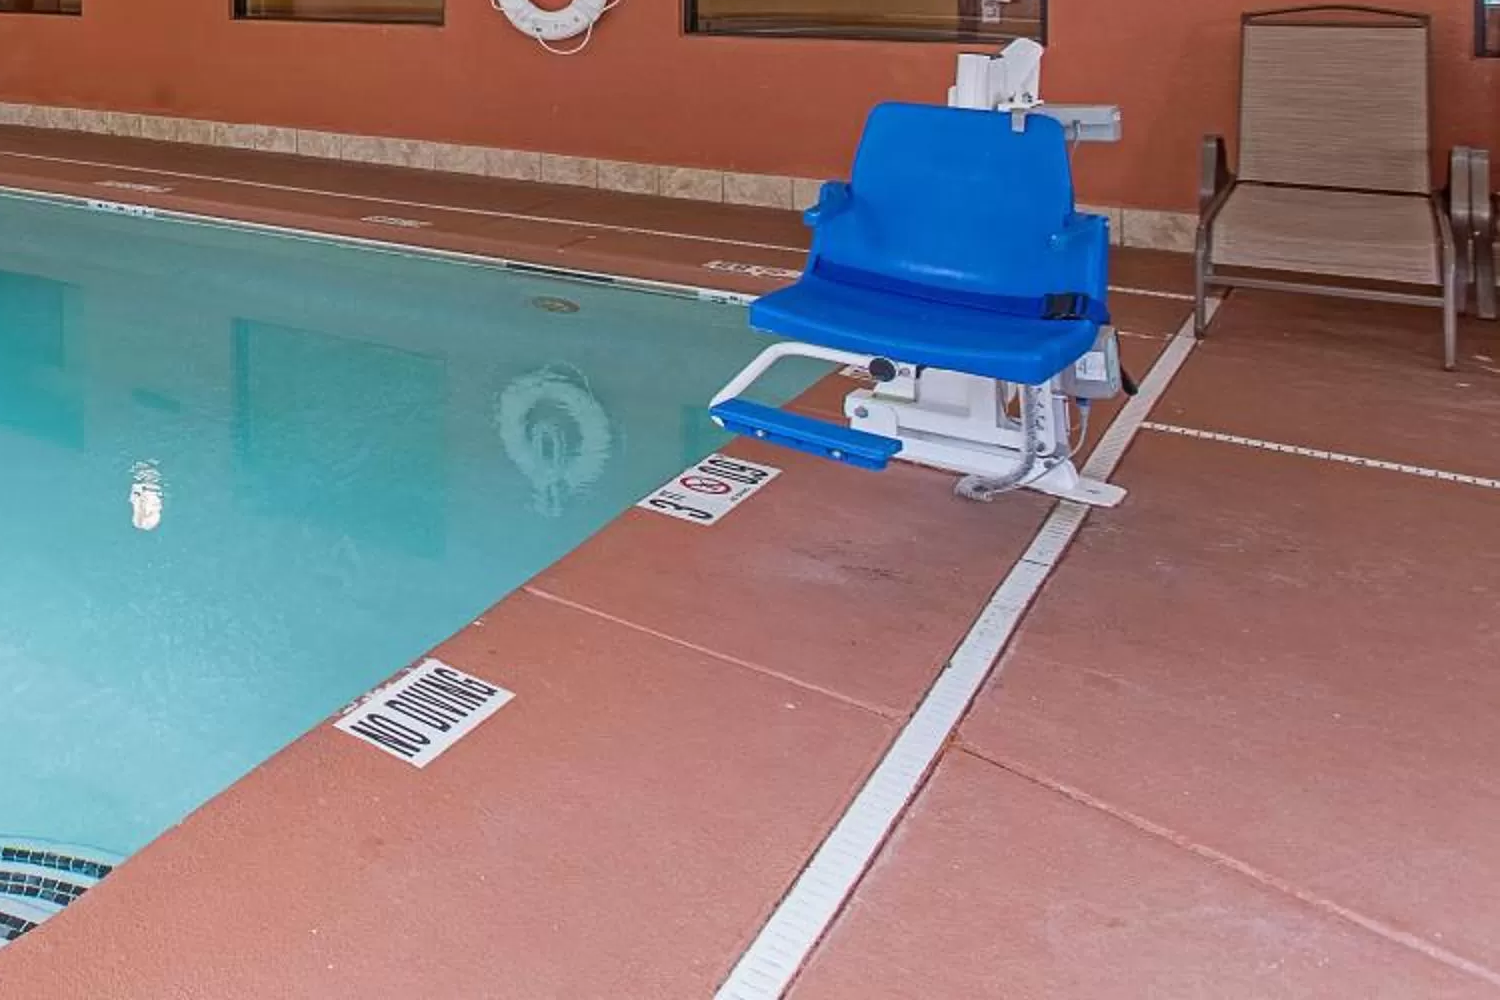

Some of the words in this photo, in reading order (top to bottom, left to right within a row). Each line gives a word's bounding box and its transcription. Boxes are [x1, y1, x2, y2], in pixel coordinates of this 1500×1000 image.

[649, 499, 714, 520] 3
[384, 667, 498, 732] DIVING
[349, 713, 431, 758] NO
